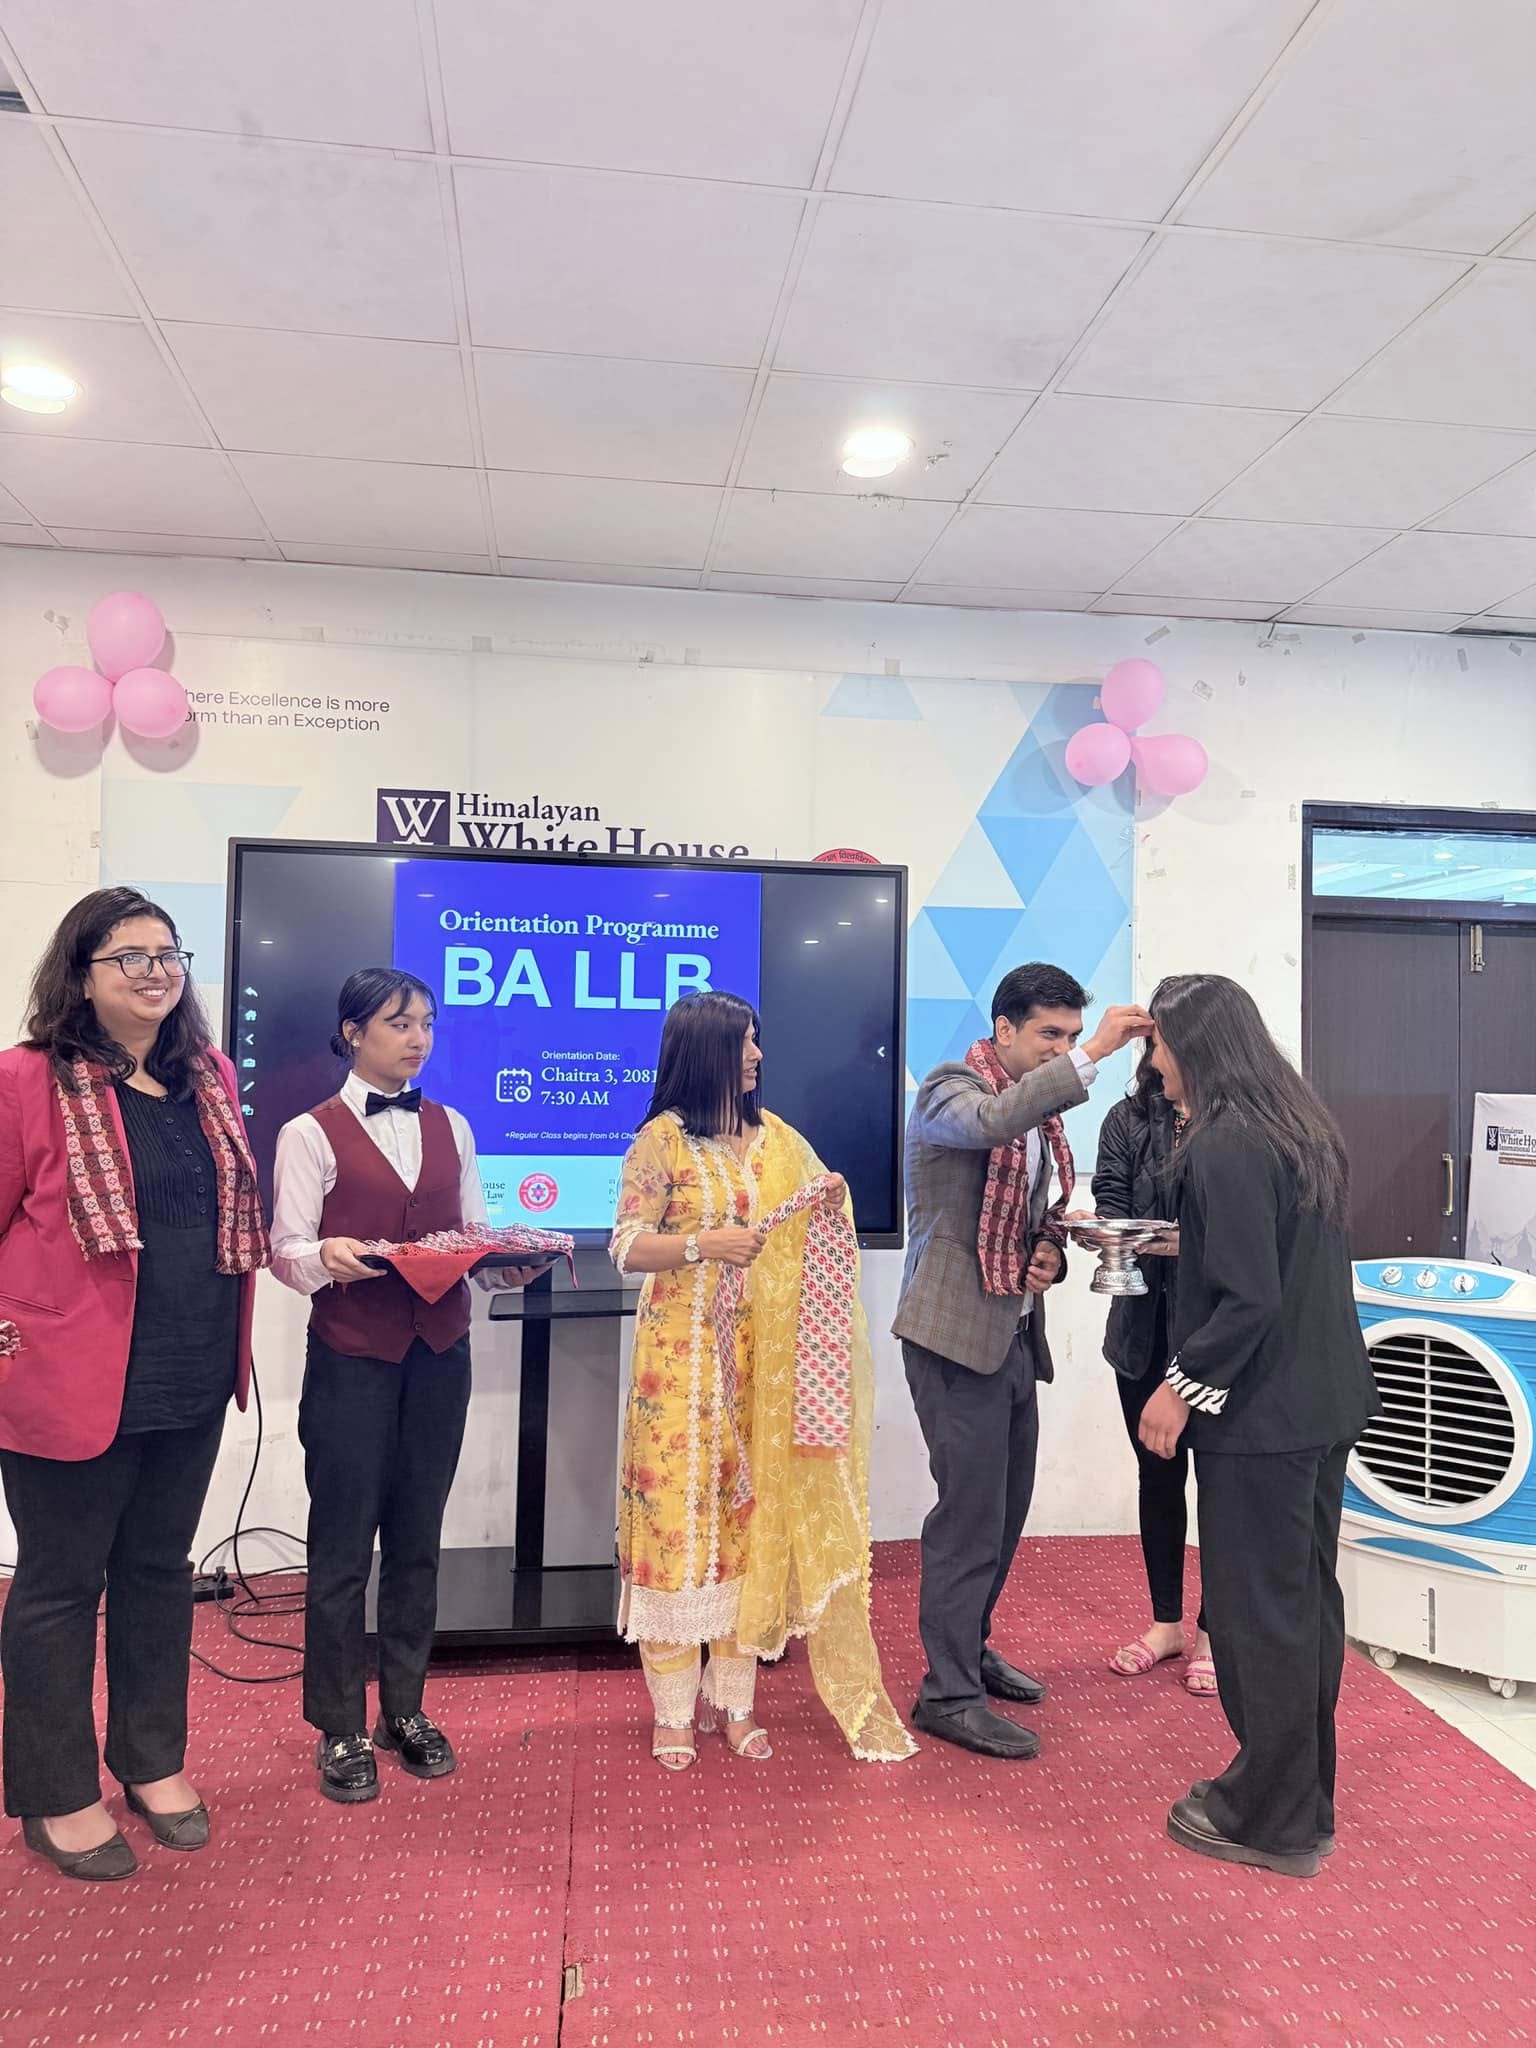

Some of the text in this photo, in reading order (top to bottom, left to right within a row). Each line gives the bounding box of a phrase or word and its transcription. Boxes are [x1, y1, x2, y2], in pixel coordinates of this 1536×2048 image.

[185, 689, 390, 712] here Excellence is more
[185, 711, 380, 732] orm than an Exception
[456, 792, 601, 826] Himalayan
[439, 909, 720, 944] Orientation Programme
[443, 946, 714, 1010] BA LLB
[541, 1050, 620, 1061] Orientation Date:
[541, 1066, 658, 1084] Chaitra 3, 2081
[541, 1091, 610, 1105] 7:30 AM
[540, 1131, 561, 1139] Class
[563, 1131, 588, 1140] begins
[589, 1131, 608, 1141] from
[620, 1132, 637, 1140] Cha
[1499, 1133, 1536, 1146] WhiteHo
[482, 1182, 505, 1190] ouse
